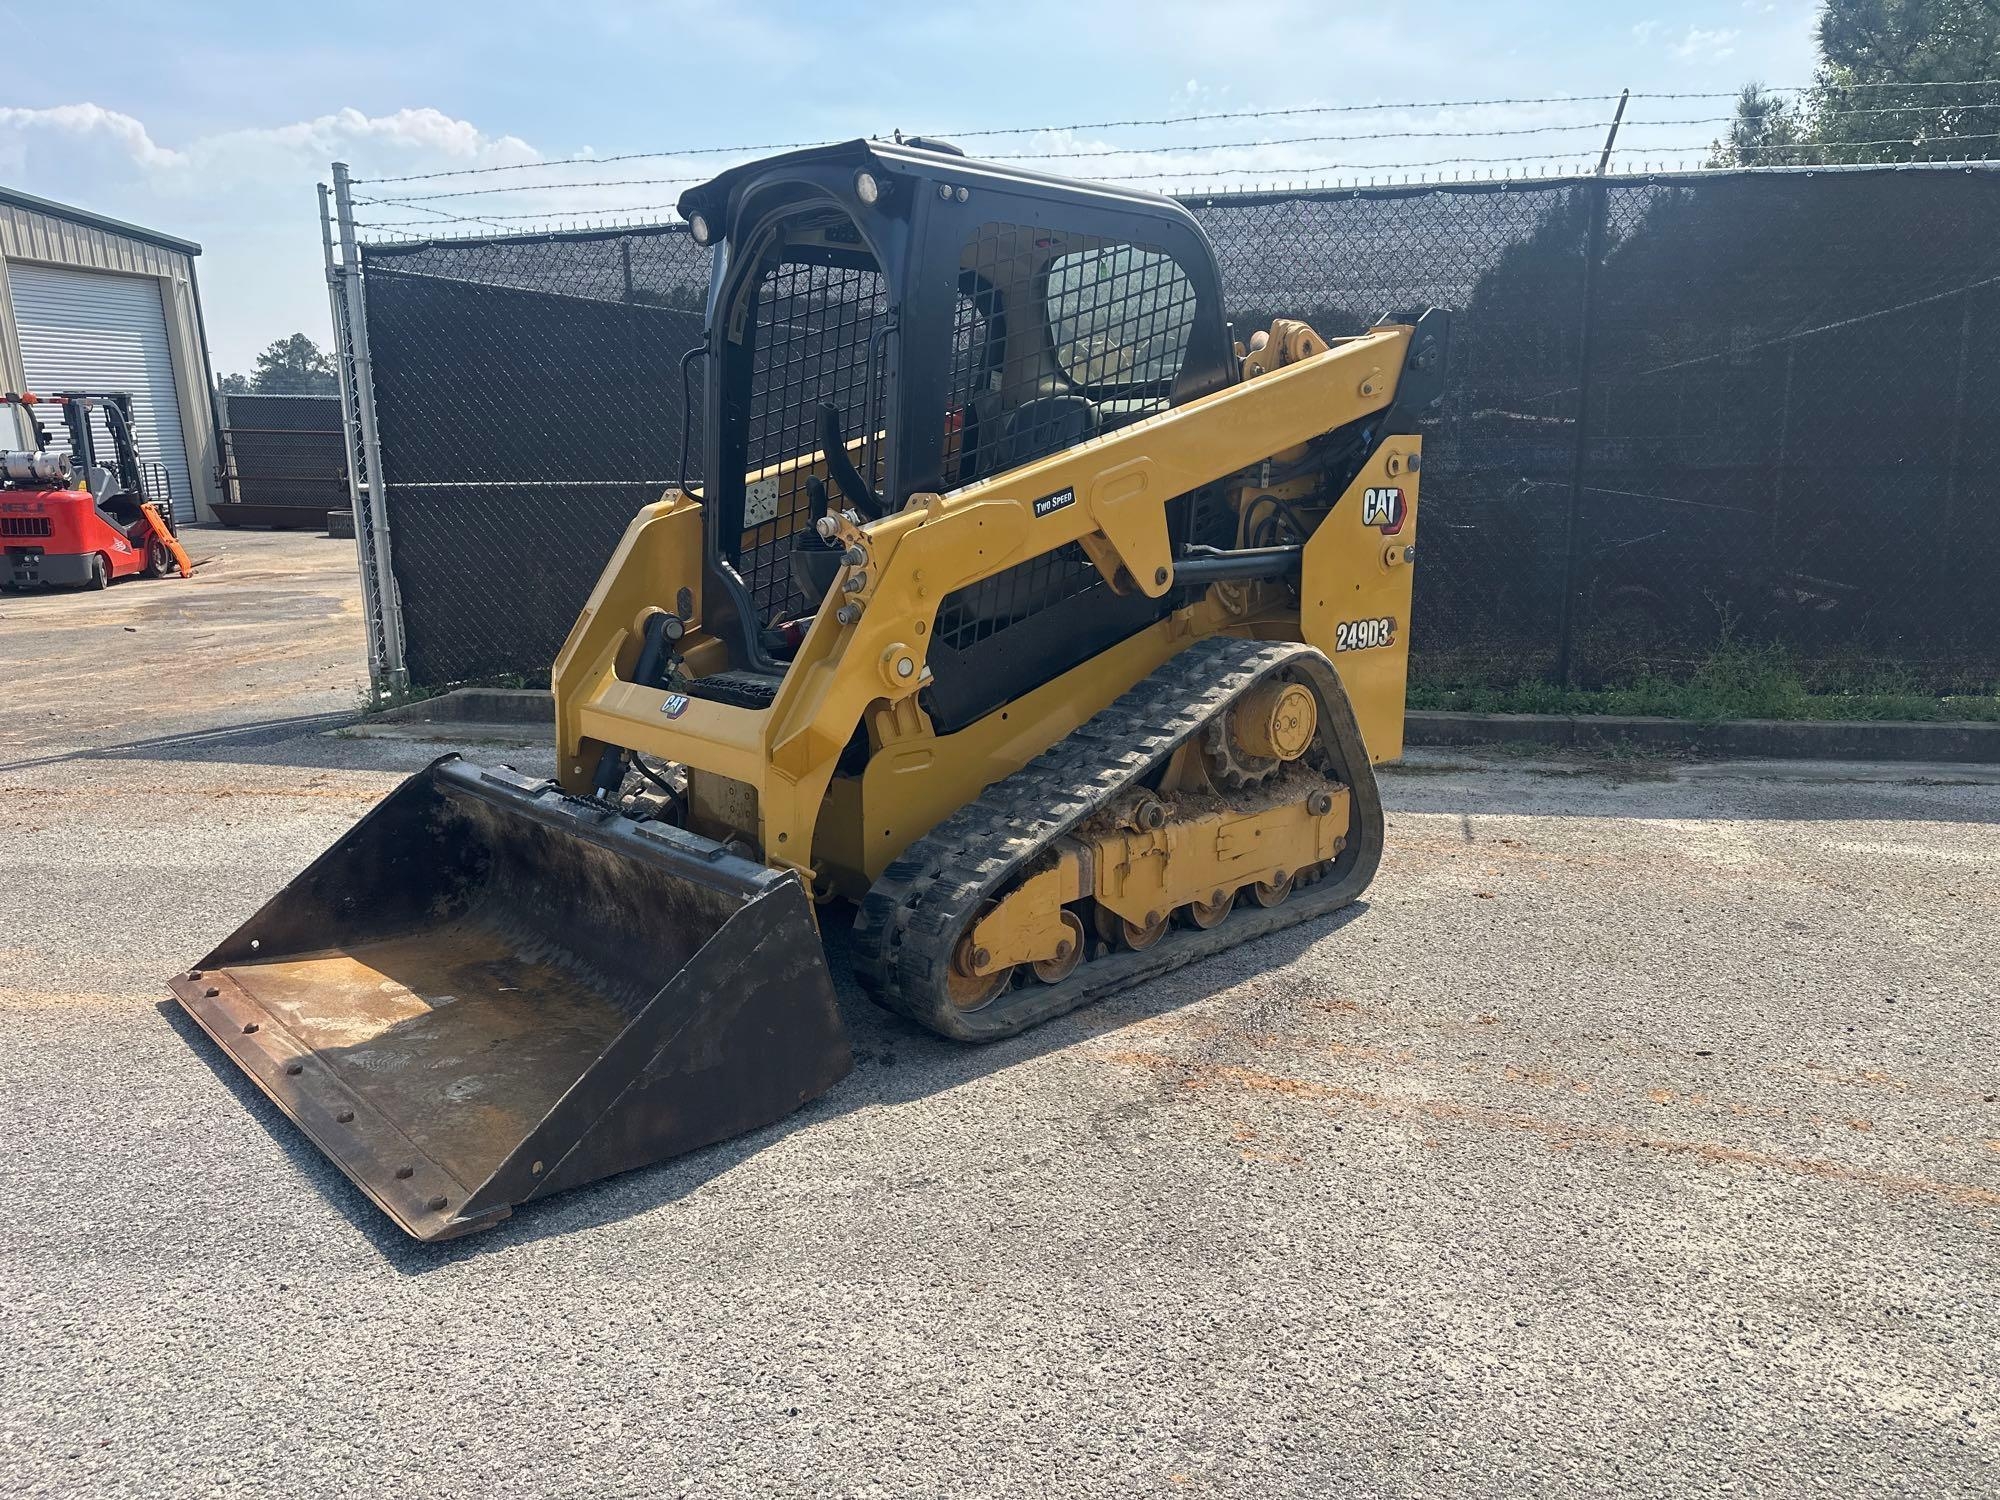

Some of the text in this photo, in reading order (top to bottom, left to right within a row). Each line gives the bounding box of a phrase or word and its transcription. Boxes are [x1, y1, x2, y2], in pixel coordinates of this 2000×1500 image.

[1036, 492, 1072, 514] TWO SPEED
[1364, 488, 1398, 525] CAT
[1336, 618, 1389, 652] 249D3
[661, 694, 688, 714] CAT
